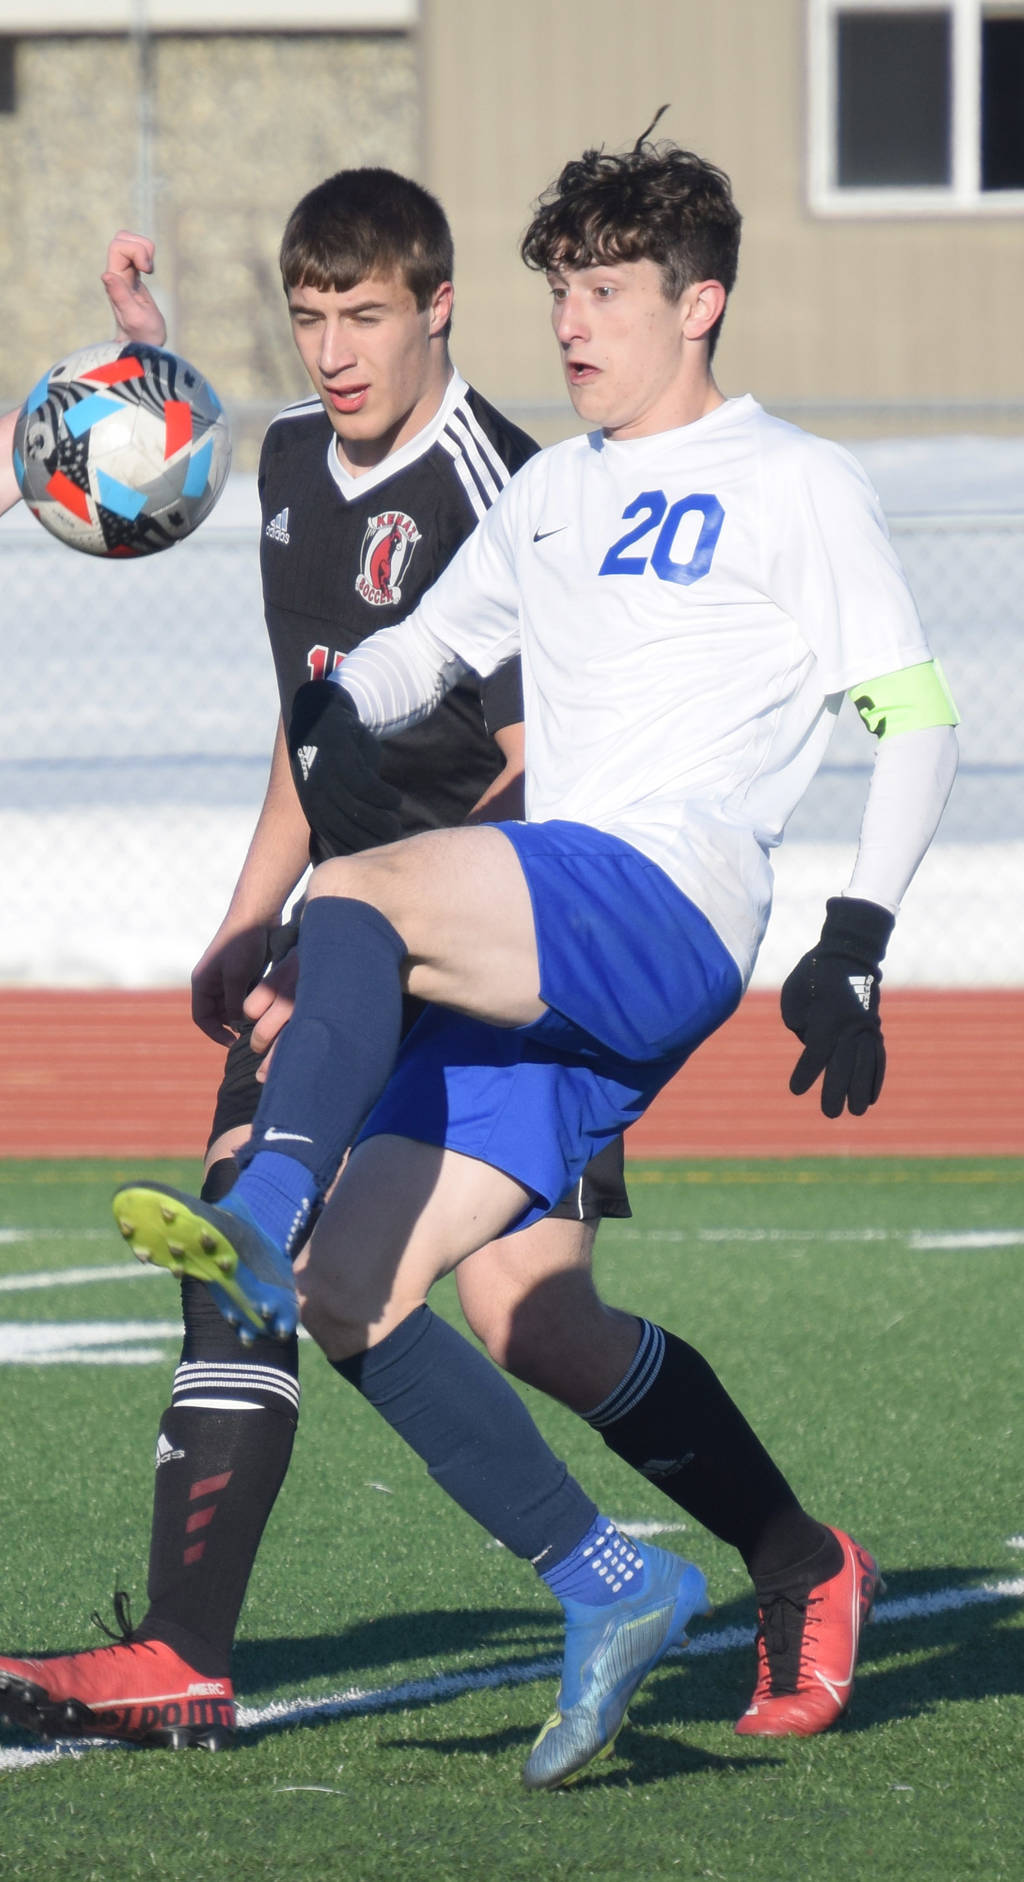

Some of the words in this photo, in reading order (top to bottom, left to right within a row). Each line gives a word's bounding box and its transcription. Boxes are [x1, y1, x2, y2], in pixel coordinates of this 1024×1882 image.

[265, 524, 290, 544] adidas
[376, 513, 418, 538] KENAI
[598, 489, 726, 586] 20
[358, 577, 393, 604] SOCCER
